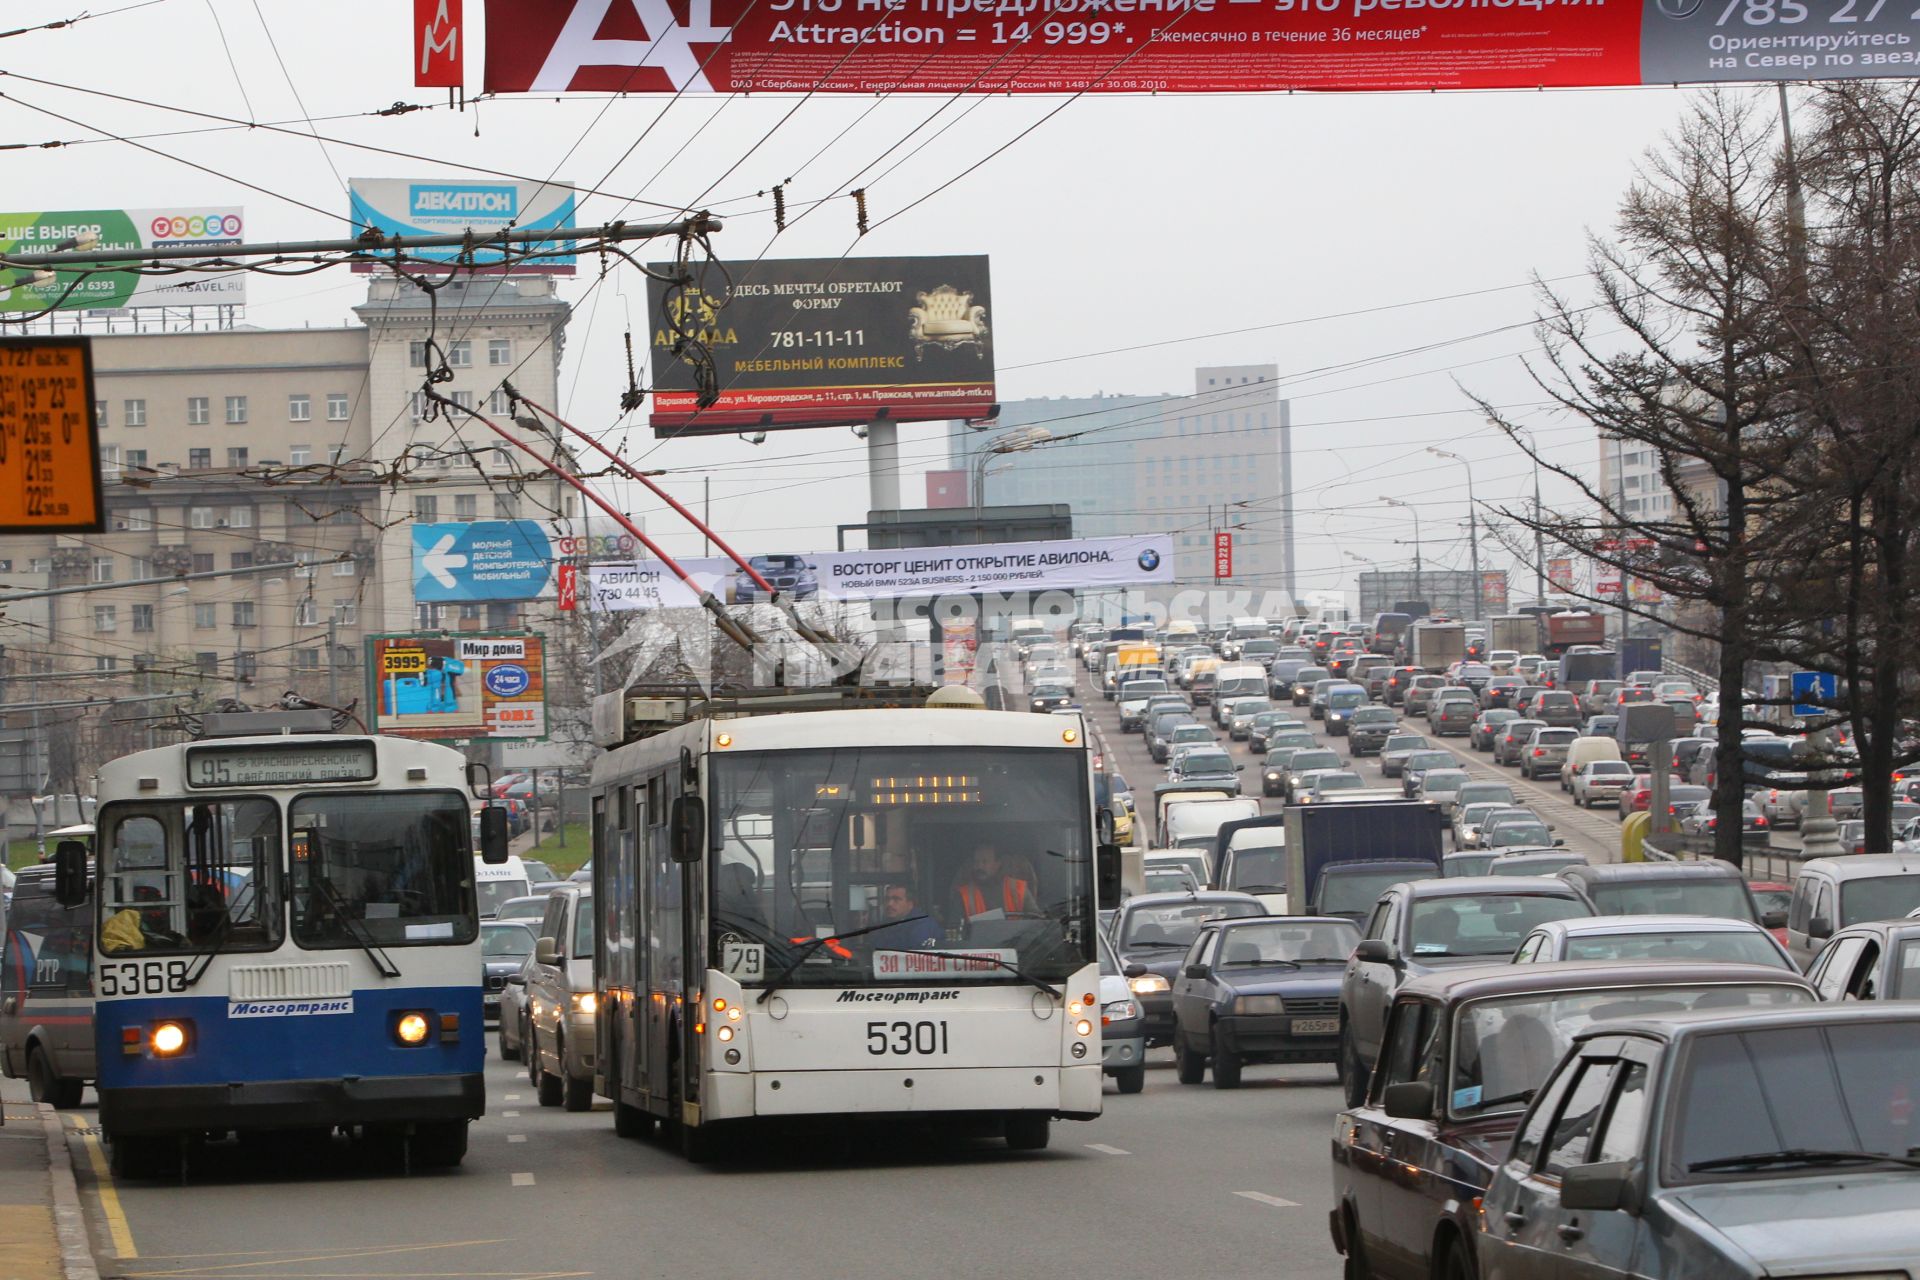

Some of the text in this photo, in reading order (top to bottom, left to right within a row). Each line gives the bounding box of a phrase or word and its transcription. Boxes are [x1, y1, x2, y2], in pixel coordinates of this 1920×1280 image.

[768, 20, 945, 44] Attraction
[991, 21, 1032, 44] 14
[1151, 28, 1247, 43] Ежемесячно
[1252, 32, 1260, 42] в
[1265, 31, 1327, 42] течение
[1331, 28, 1351, 42] 36
[1709, 31, 1911, 53] Ориентируйтесь
[1709, 56, 1737, 69] на
[1745, 53, 1817, 70] Север
[1825, 55, 1854, 67] по
[731, 80, 753, 89] ОАО
[756, 80, 811, 89] «Сбербанк
[861, 80, 925, 91] Генеральная
[928, 81, 977, 91] лицензии
[979, 81, 1007, 90] Банка
[1011, 81, 1046, 90] России
[1066, 81, 1090, 89] 1481
[415, 192, 510, 211] ДЕКАТЛОН
[88, 281, 115, 290] 6393
[774, 283, 825, 295] МЕЧТЫ
[828, 281, 903, 293] ОБРЕТАЮТ
[793, 298, 842, 310] ФОРМУ
[771, 330, 864, 348] 781-11-11
[735, 356, 905, 371] МЕБЕЛЬНЫЙ КОМПЛЕКС
[472, 539, 513, 549] МОДНЫЙ
[472, 550, 513, 560] ДЕТСКИЙ
[833, 550, 1114, 576] ВОСТОРГ ЦЕНИТ ОТКРЫТИЕ АВИЛОНА.
[473, 570, 530, 581] МОБИЛЬНЫЙ
[600, 570, 660, 585] АВИЛОН
[841, 577, 874, 588] НОВЫЙ
[875, 578, 897, 587] BMW
[922, 575, 964, 585] BUSINESS
[600, 587, 659, 601] 730 44 45
[463, 643, 522, 657] Мир дома
[500, 709, 534, 721] OBI
[202, 759, 230, 784] 95
[731, 948, 759, 974] 79
[880, 954, 898, 973] ЗА
[100, 961, 188, 996] 5368
[837, 989, 960, 1003] Мосгортранс
[232, 1001, 348, 1016] Мосгортранс
[867, 1021, 949, 1056] 5301
